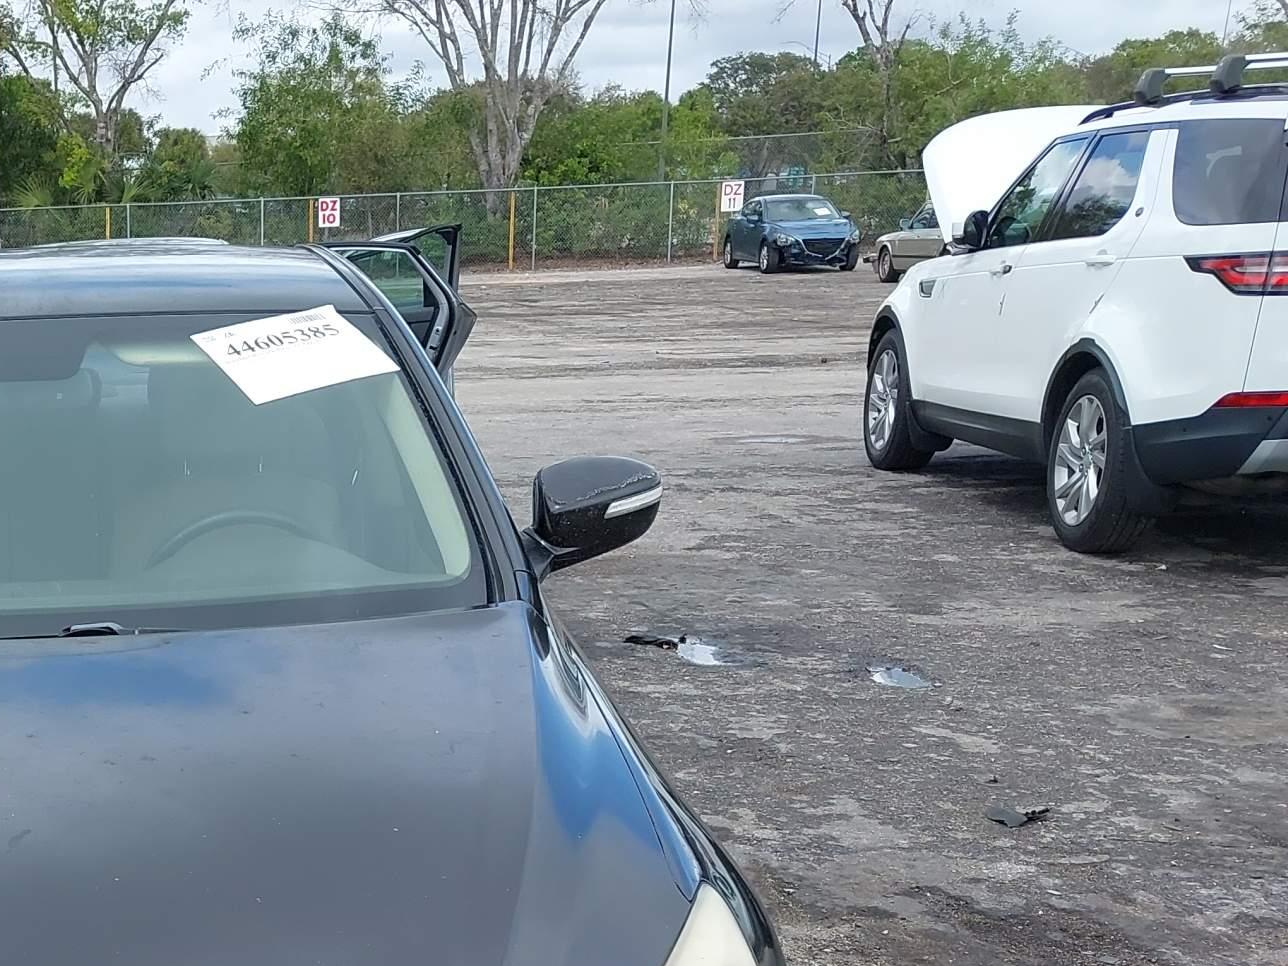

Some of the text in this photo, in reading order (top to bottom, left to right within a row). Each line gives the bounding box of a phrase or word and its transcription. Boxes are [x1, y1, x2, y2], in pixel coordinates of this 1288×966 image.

[724, 184, 742, 196] DZ
[321, 200, 337, 212] DZ
[728, 197, 737, 208] 11
[322, 213, 336, 224] 10
[226, 324, 340, 357] 44605385
